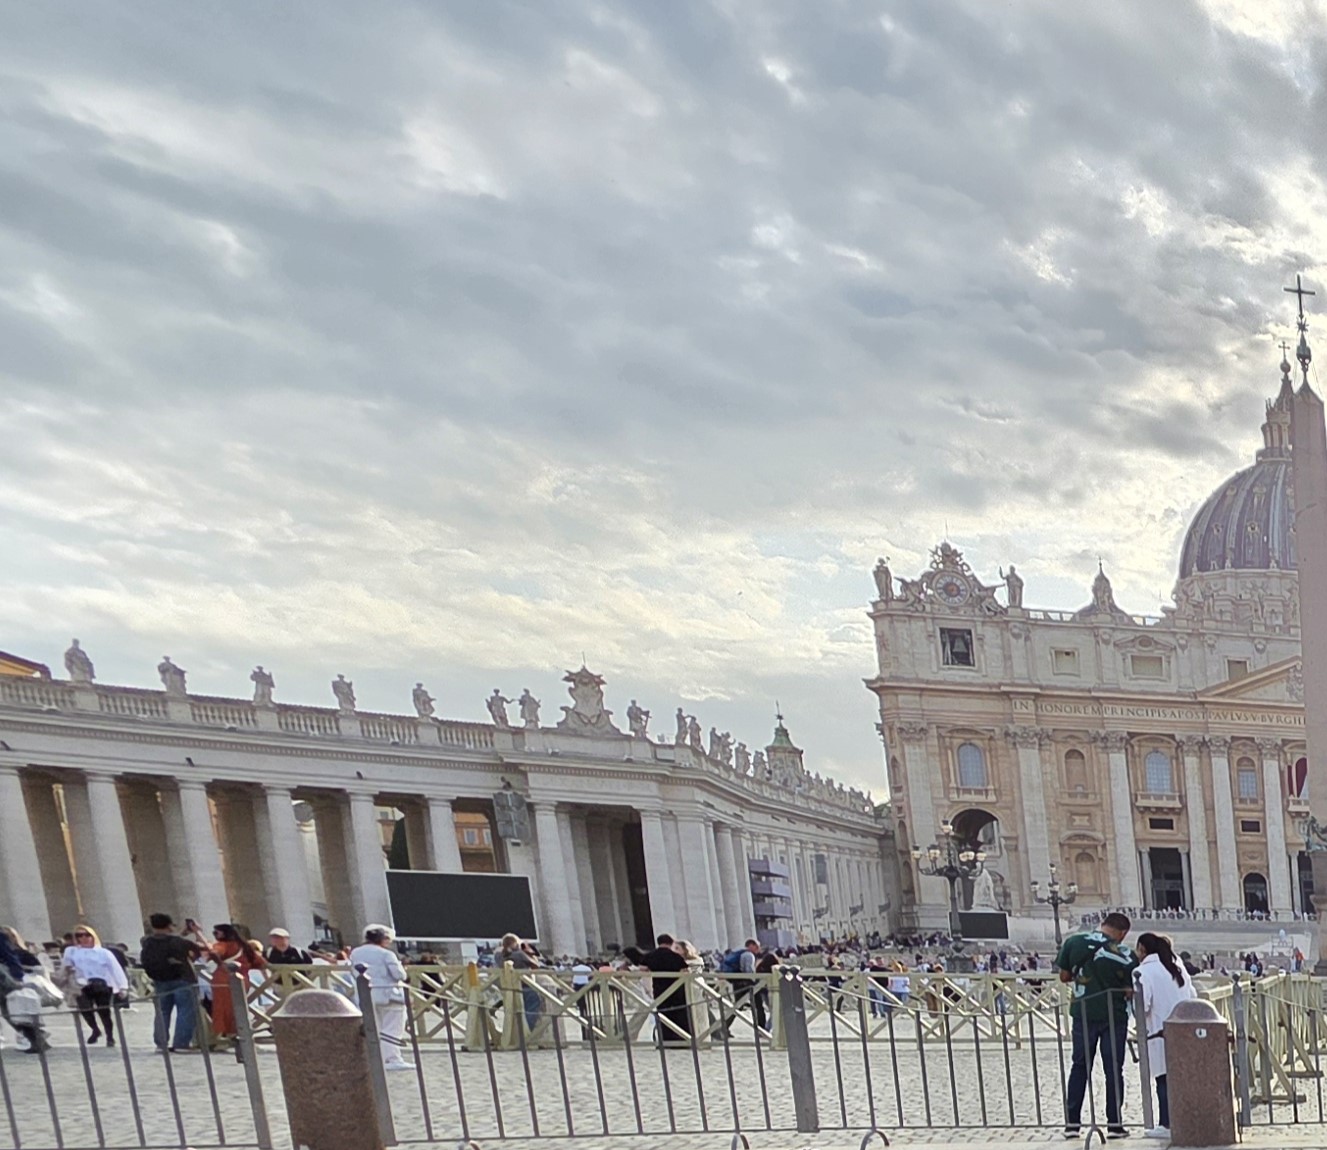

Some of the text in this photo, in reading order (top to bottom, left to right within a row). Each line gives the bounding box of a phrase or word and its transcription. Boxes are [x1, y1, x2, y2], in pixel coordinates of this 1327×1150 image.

[1013, 701, 1029, 710] IN
[1037, 703, 1101, 716] HONOREM
[1104, 705, 1167, 718] PRINCIPIS
[1169, 709, 1206, 720] APOST
[1260, 714, 1306, 725] BVRGH
